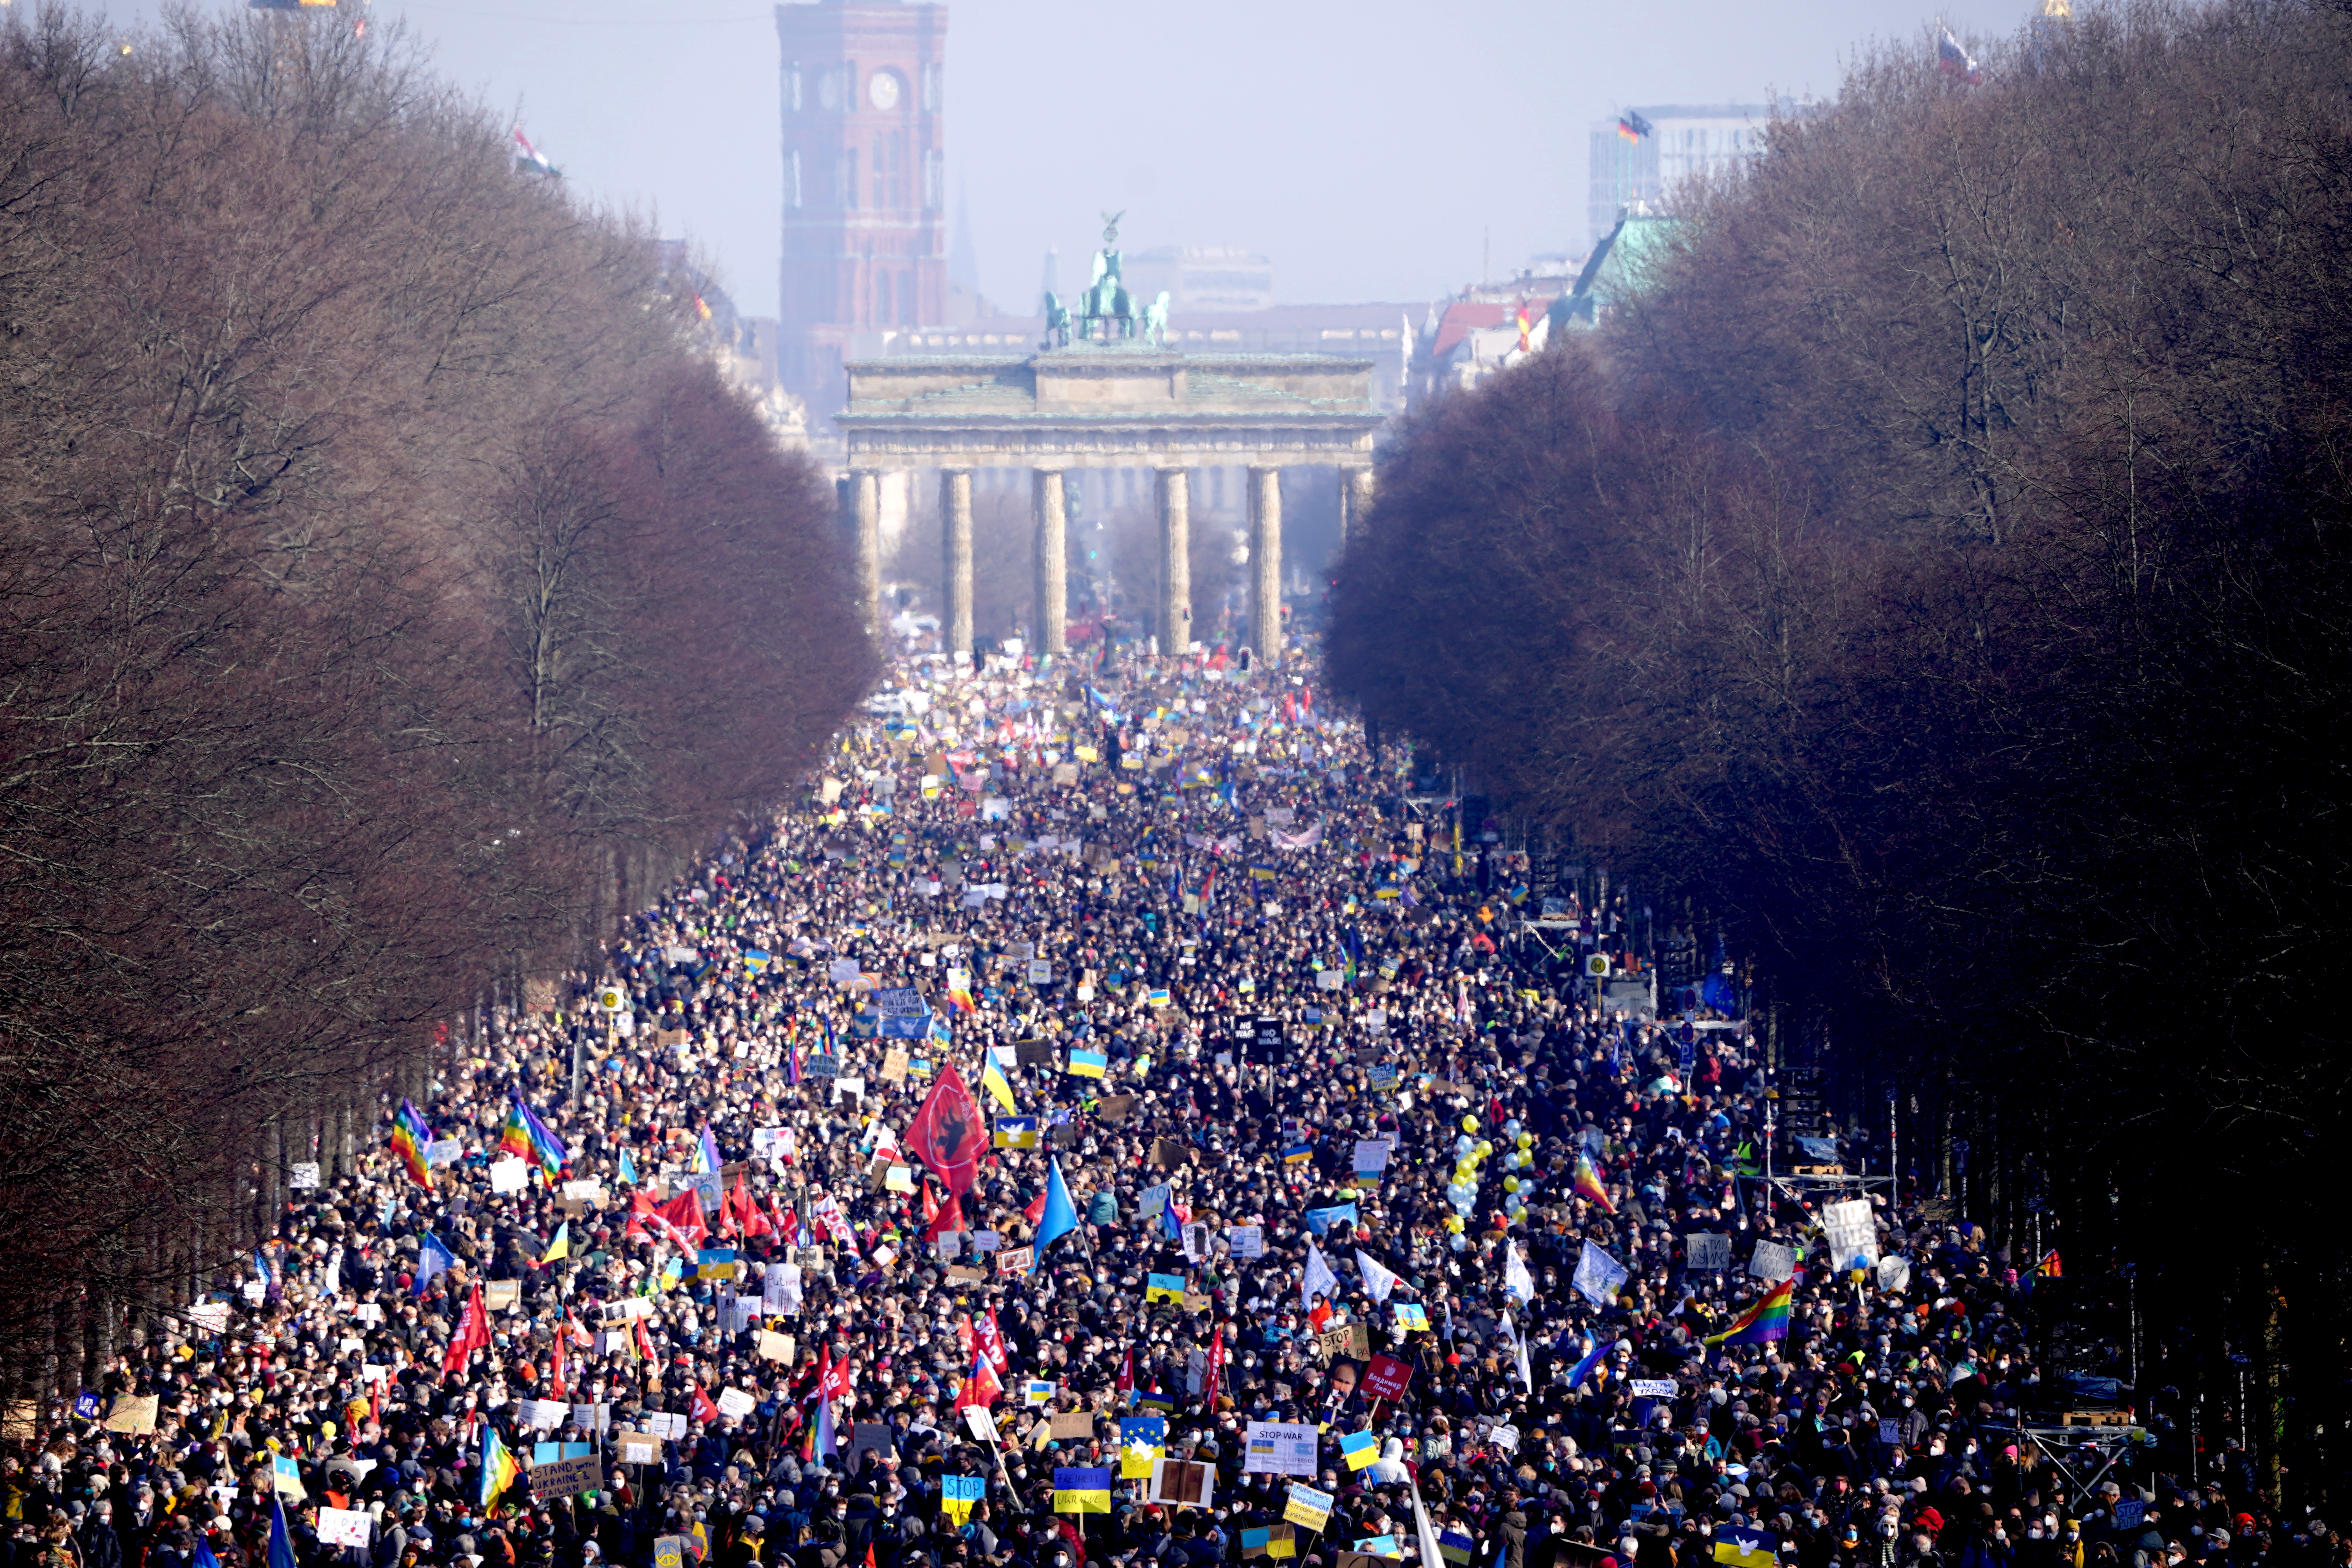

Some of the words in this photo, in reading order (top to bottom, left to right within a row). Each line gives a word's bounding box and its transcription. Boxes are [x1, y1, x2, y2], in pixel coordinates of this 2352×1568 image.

[1240, 1021, 1252, 1030] NO
[1261, 1029, 1276, 1039] NO
[1682, 1044, 1690, 1062] P
[1146, 1186, 1166, 1201] NO
[1824, 1201, 1870, 1227] STOP
[1827, 1223, 1875, 1249] THIS
[1689, 1240, 1728, 1251] ПУТИН
[1758, 1241, 1794, 1262] HANDS
[1753, 1261, 1791, 1281] UKRAINE
[1764, 1258, 1781, 1269] OFF
[1324, 1329, 1350, 1347] STOP
[1368, 1372, 1402, 1390] Владимир
[1633, 1380, 1671, 1388] ПУТИН
[1373, 1383, 1392, 1396] Лжец
[1259, 1430, 1282, 1441] STOP
[1283, 1432, 1302, 1441] WAR
[534, 1462, 573, 1479] STAND
[535, 1472, 579, 1490] UKRAINE
[583, 1471, 590, 1480] &
[947, 1478, 980, 1498] STOP
[543, 1484, 579, 1497] TAIWAN
[1296, 1484, 1312, 1495] Putin
[1057, 1494, 1105, 1505] UKRAINE
[1290, 1492, 1329, 1512] Kriegsgericht
[946, 1501, 969, 1520] WA
[1284, 1509, 1323, 1528] Sanktionsliste
[1315, 1508, 1326, 1520] auf
[2118, 1503, 2142, 1518] STOP
